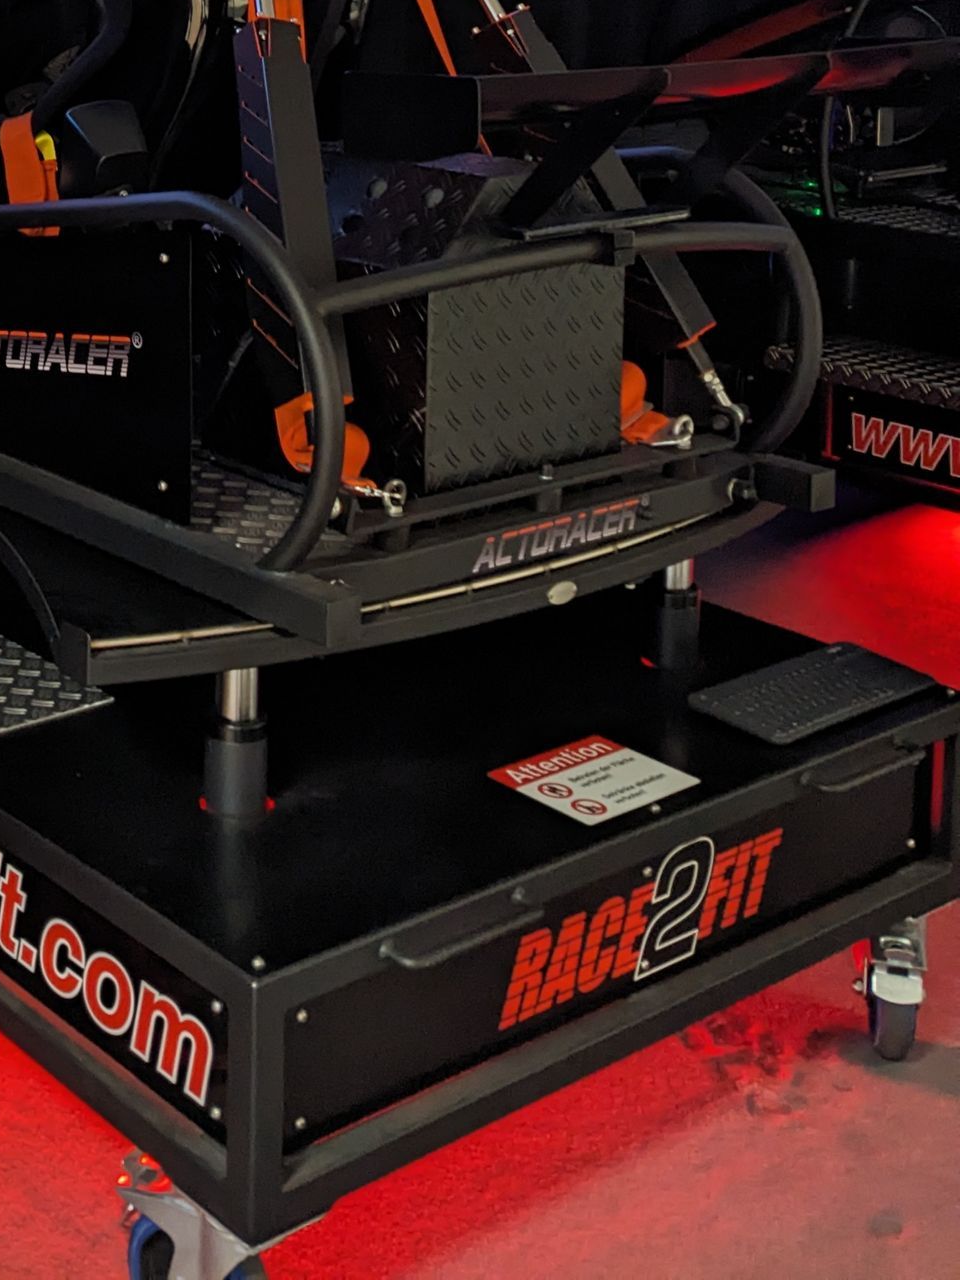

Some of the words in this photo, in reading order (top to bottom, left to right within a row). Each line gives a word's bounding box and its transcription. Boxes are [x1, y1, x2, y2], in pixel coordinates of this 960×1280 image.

[851, 412, 960, 478] ww
[505, 741, 614, 784] Attention
[497, 826, 784, 1032] RACE2FIT
